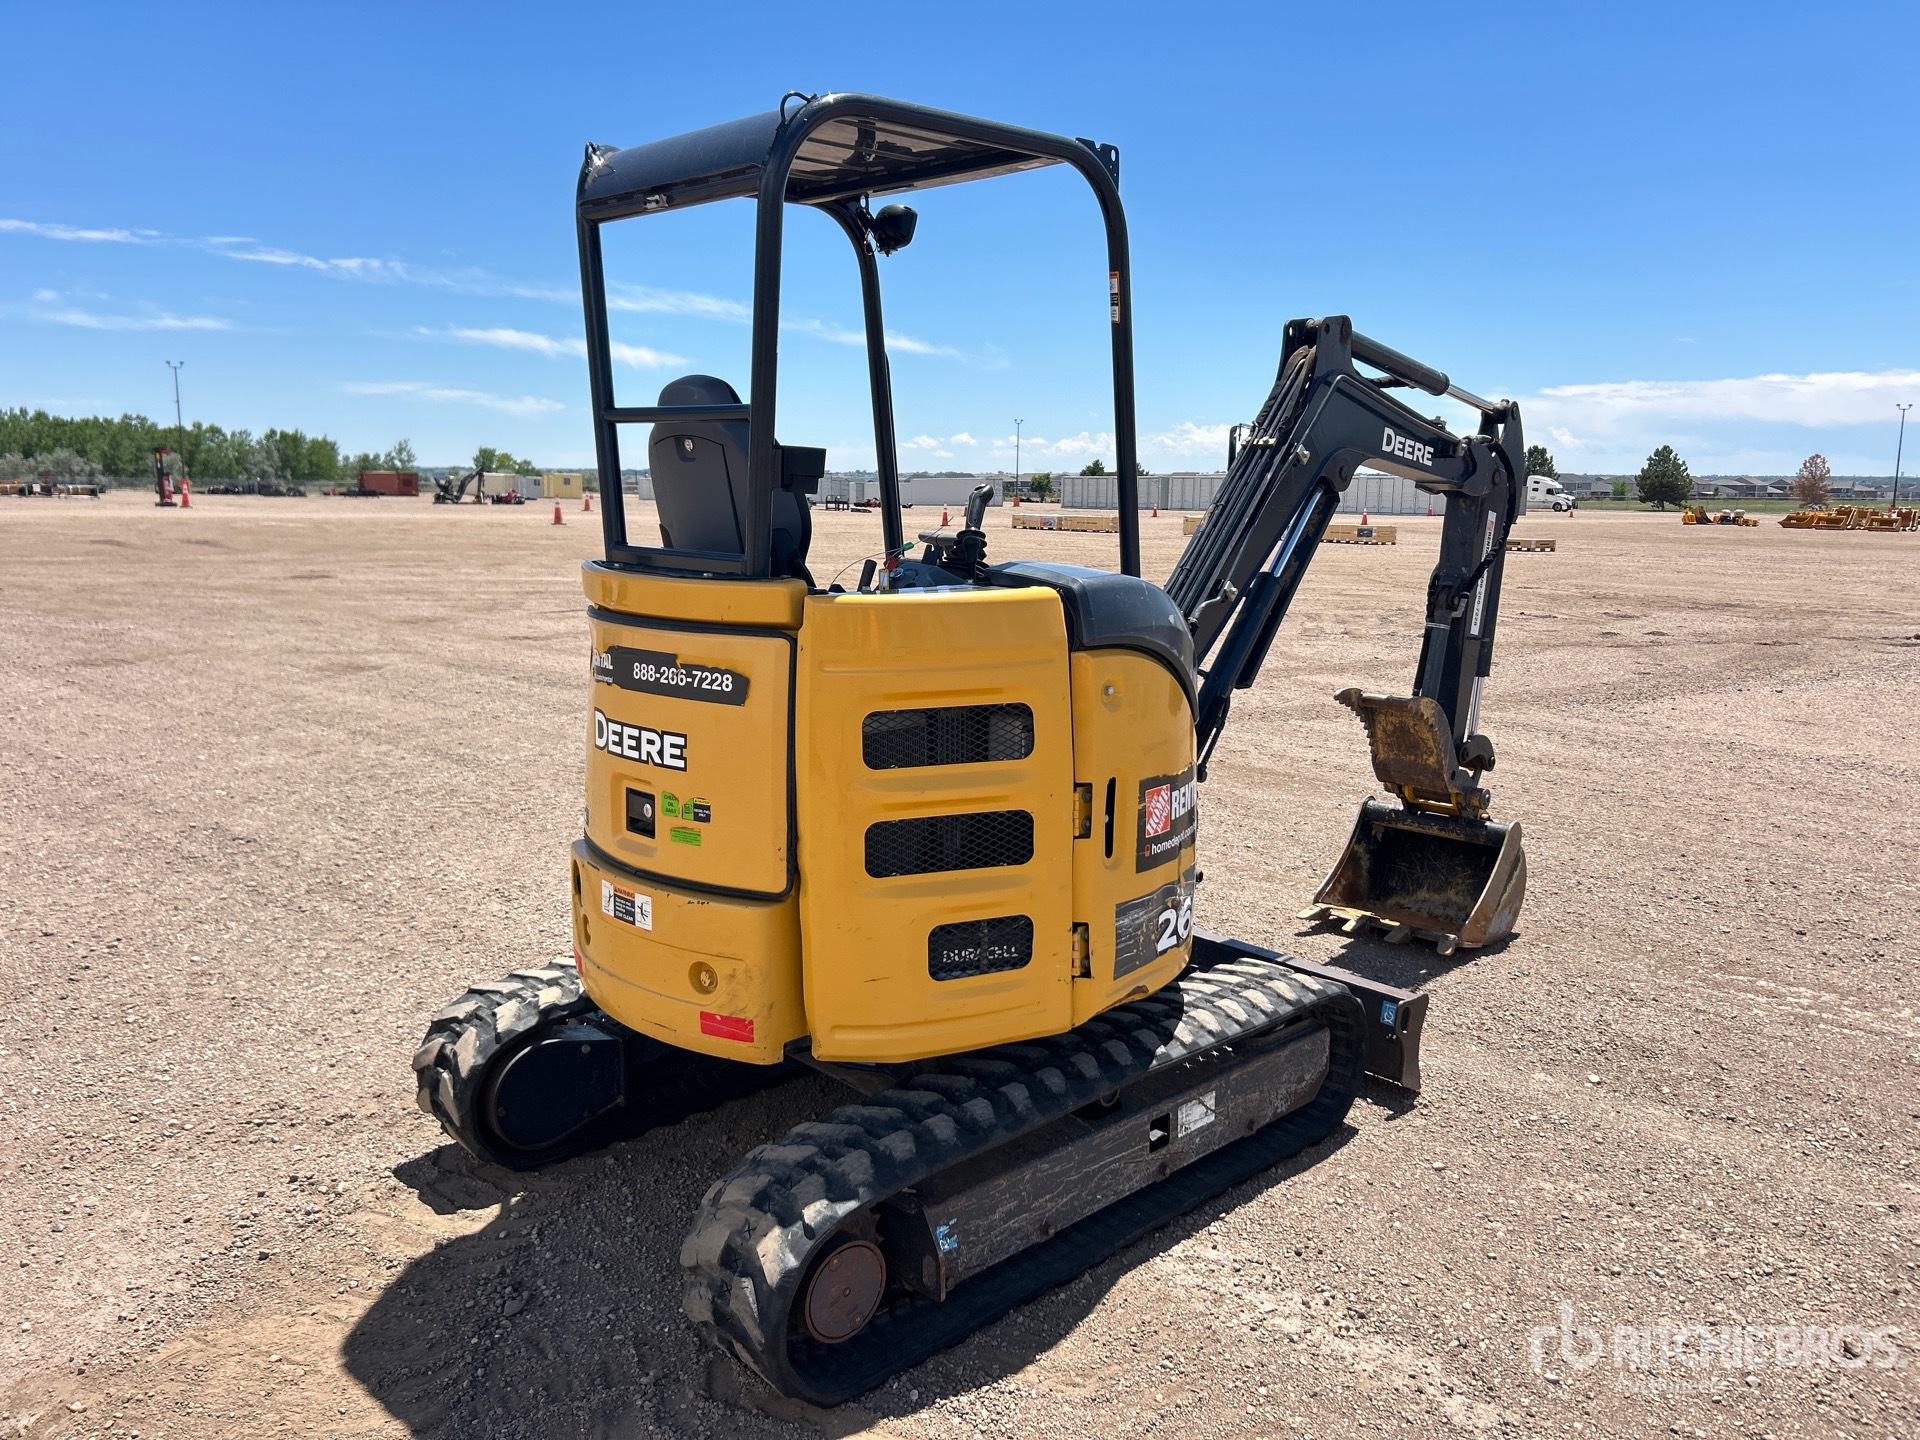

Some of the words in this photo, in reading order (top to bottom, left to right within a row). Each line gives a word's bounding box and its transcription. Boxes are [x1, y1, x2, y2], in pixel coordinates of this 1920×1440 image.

[1382, 426, 1434, 466] DEERE
[633, 662, 733, 692] 888-266-7228
[594, 708, 686, 769] DEERE
[1146, 785, 1169, 835] HOME
